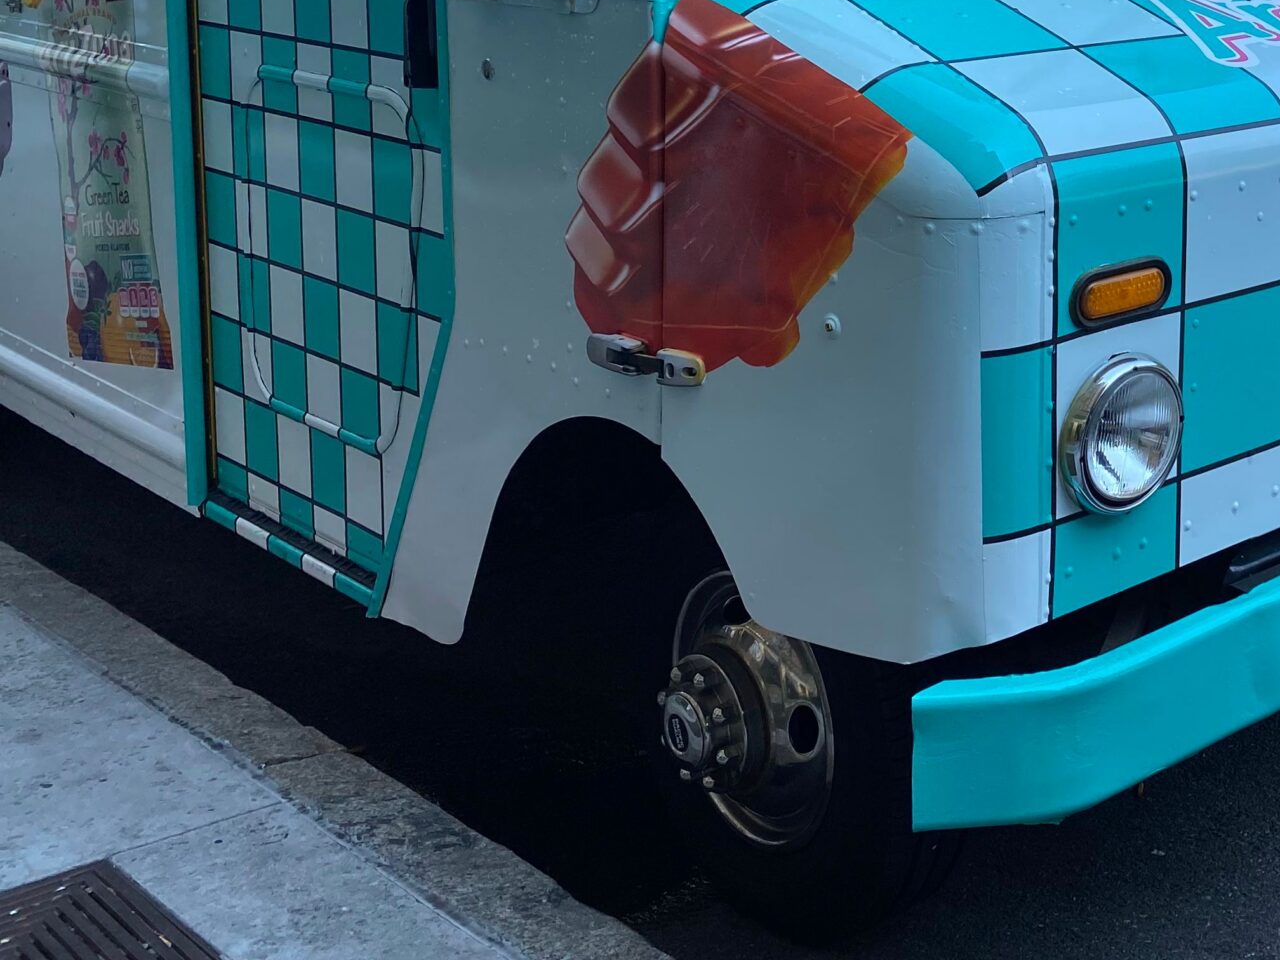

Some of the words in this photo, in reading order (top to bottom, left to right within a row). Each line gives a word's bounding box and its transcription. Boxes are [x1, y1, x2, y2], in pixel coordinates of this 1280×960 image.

[85, 184, 113, 207] Green
[112, 182, 130, 205] Tea
[81, 211, 104, 238] Fruit
[105, 210, 140, 238] Snacks
[121, 258, 134, 280] NO
